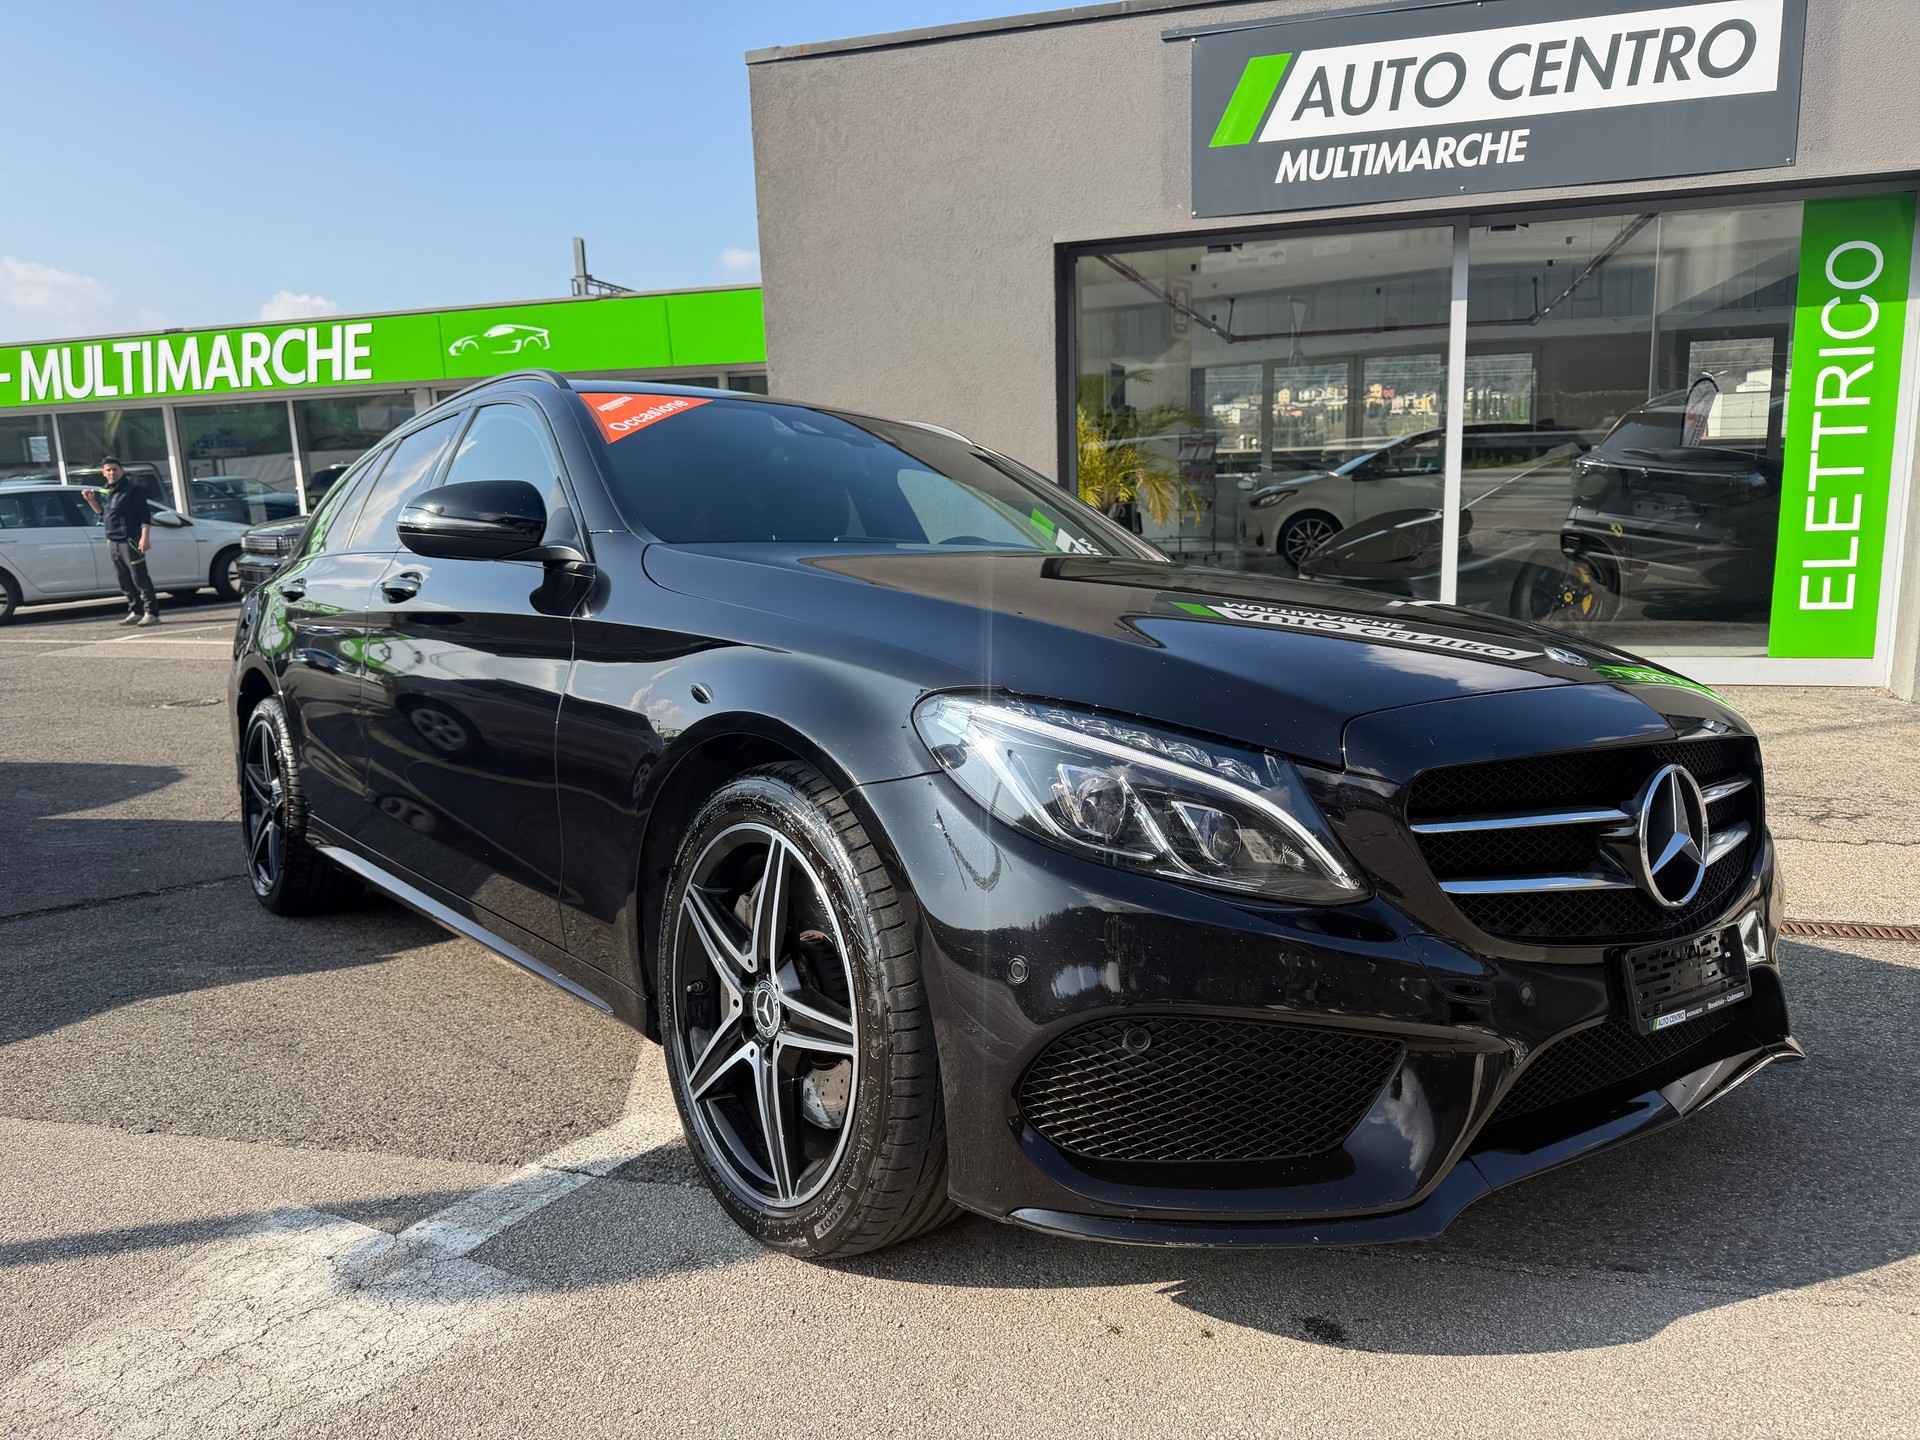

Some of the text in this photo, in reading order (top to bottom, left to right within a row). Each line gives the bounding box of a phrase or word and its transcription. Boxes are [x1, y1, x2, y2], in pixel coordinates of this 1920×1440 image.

[1290, 18, 1757, 122] AUTO CENTRO
[1275, 129, 1530, 184] MULTIMARCHE
[21, 323, 373, 402] MULTIMARCHE
[610, 400, 688, 431] Occasione
[1799, 240, 1884, 611] ELETTRICO
